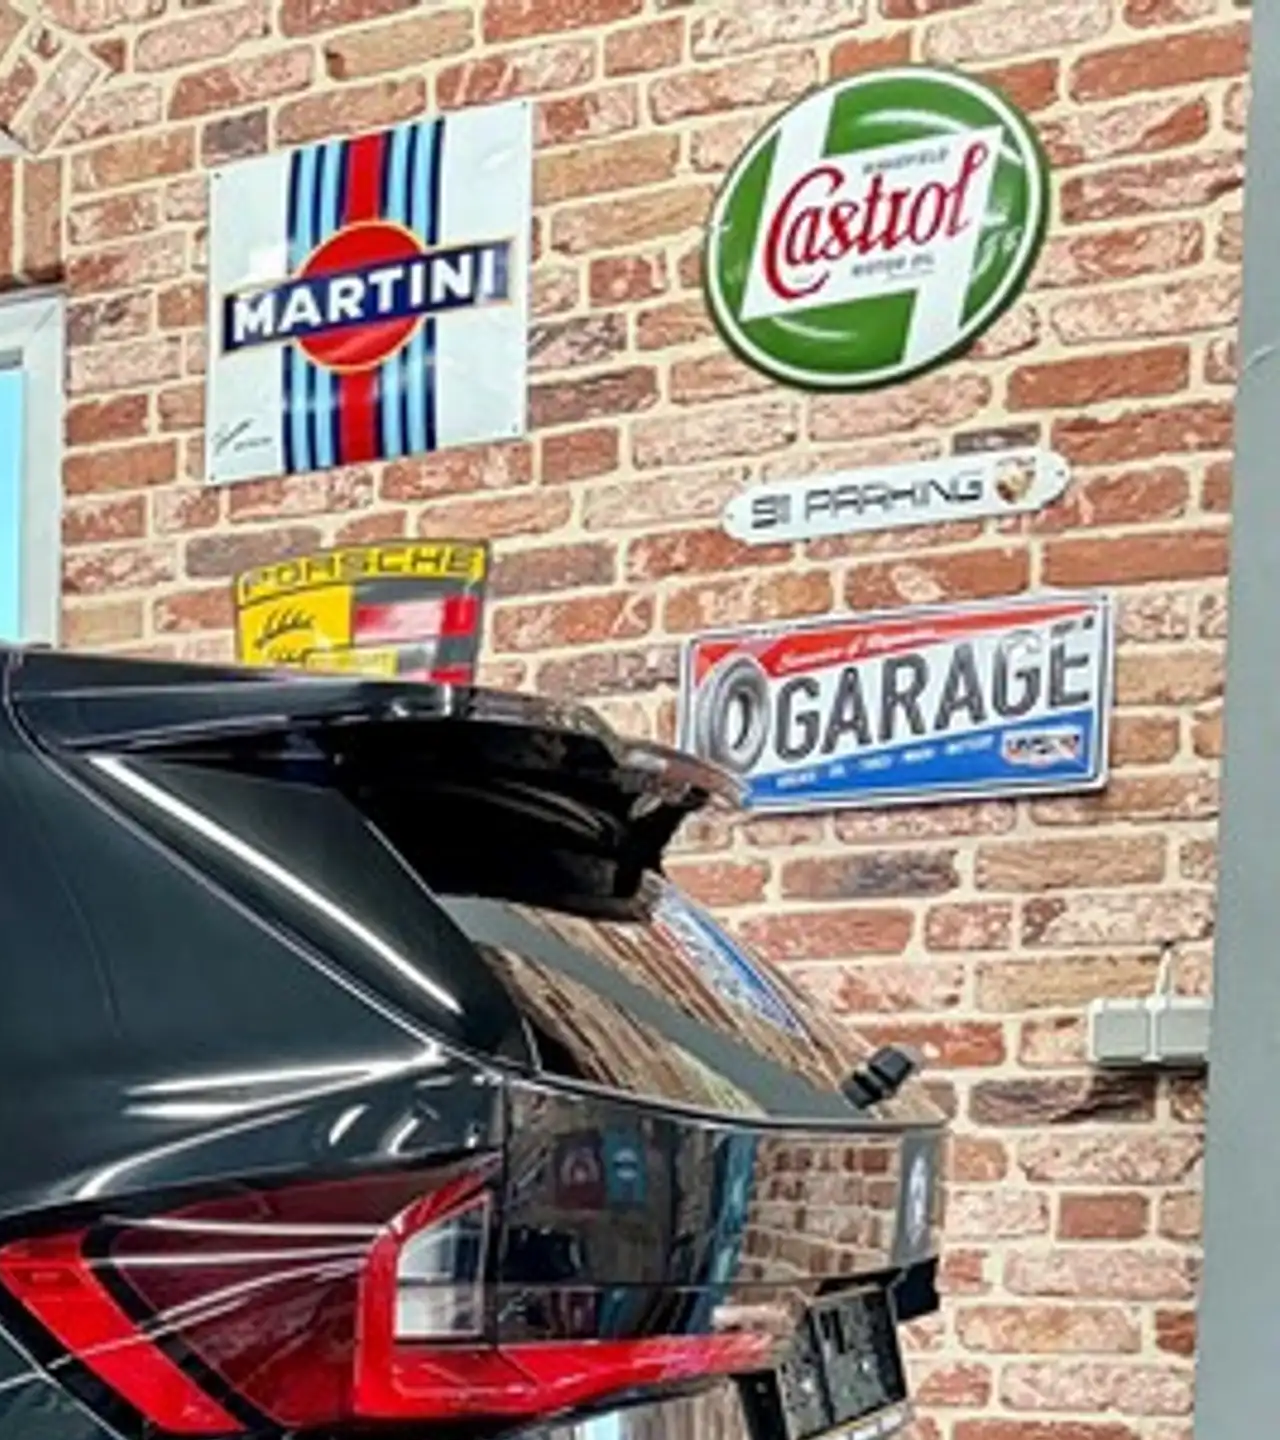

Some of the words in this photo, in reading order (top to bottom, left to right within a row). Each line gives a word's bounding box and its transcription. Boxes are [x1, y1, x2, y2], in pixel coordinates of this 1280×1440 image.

[763, 140, 990, 301] Castrol
[232, 248, 496, 343] MARTINI
[804, 469, 984, 525] PARKING
[774, 614, 1095, 763] GARAGE
